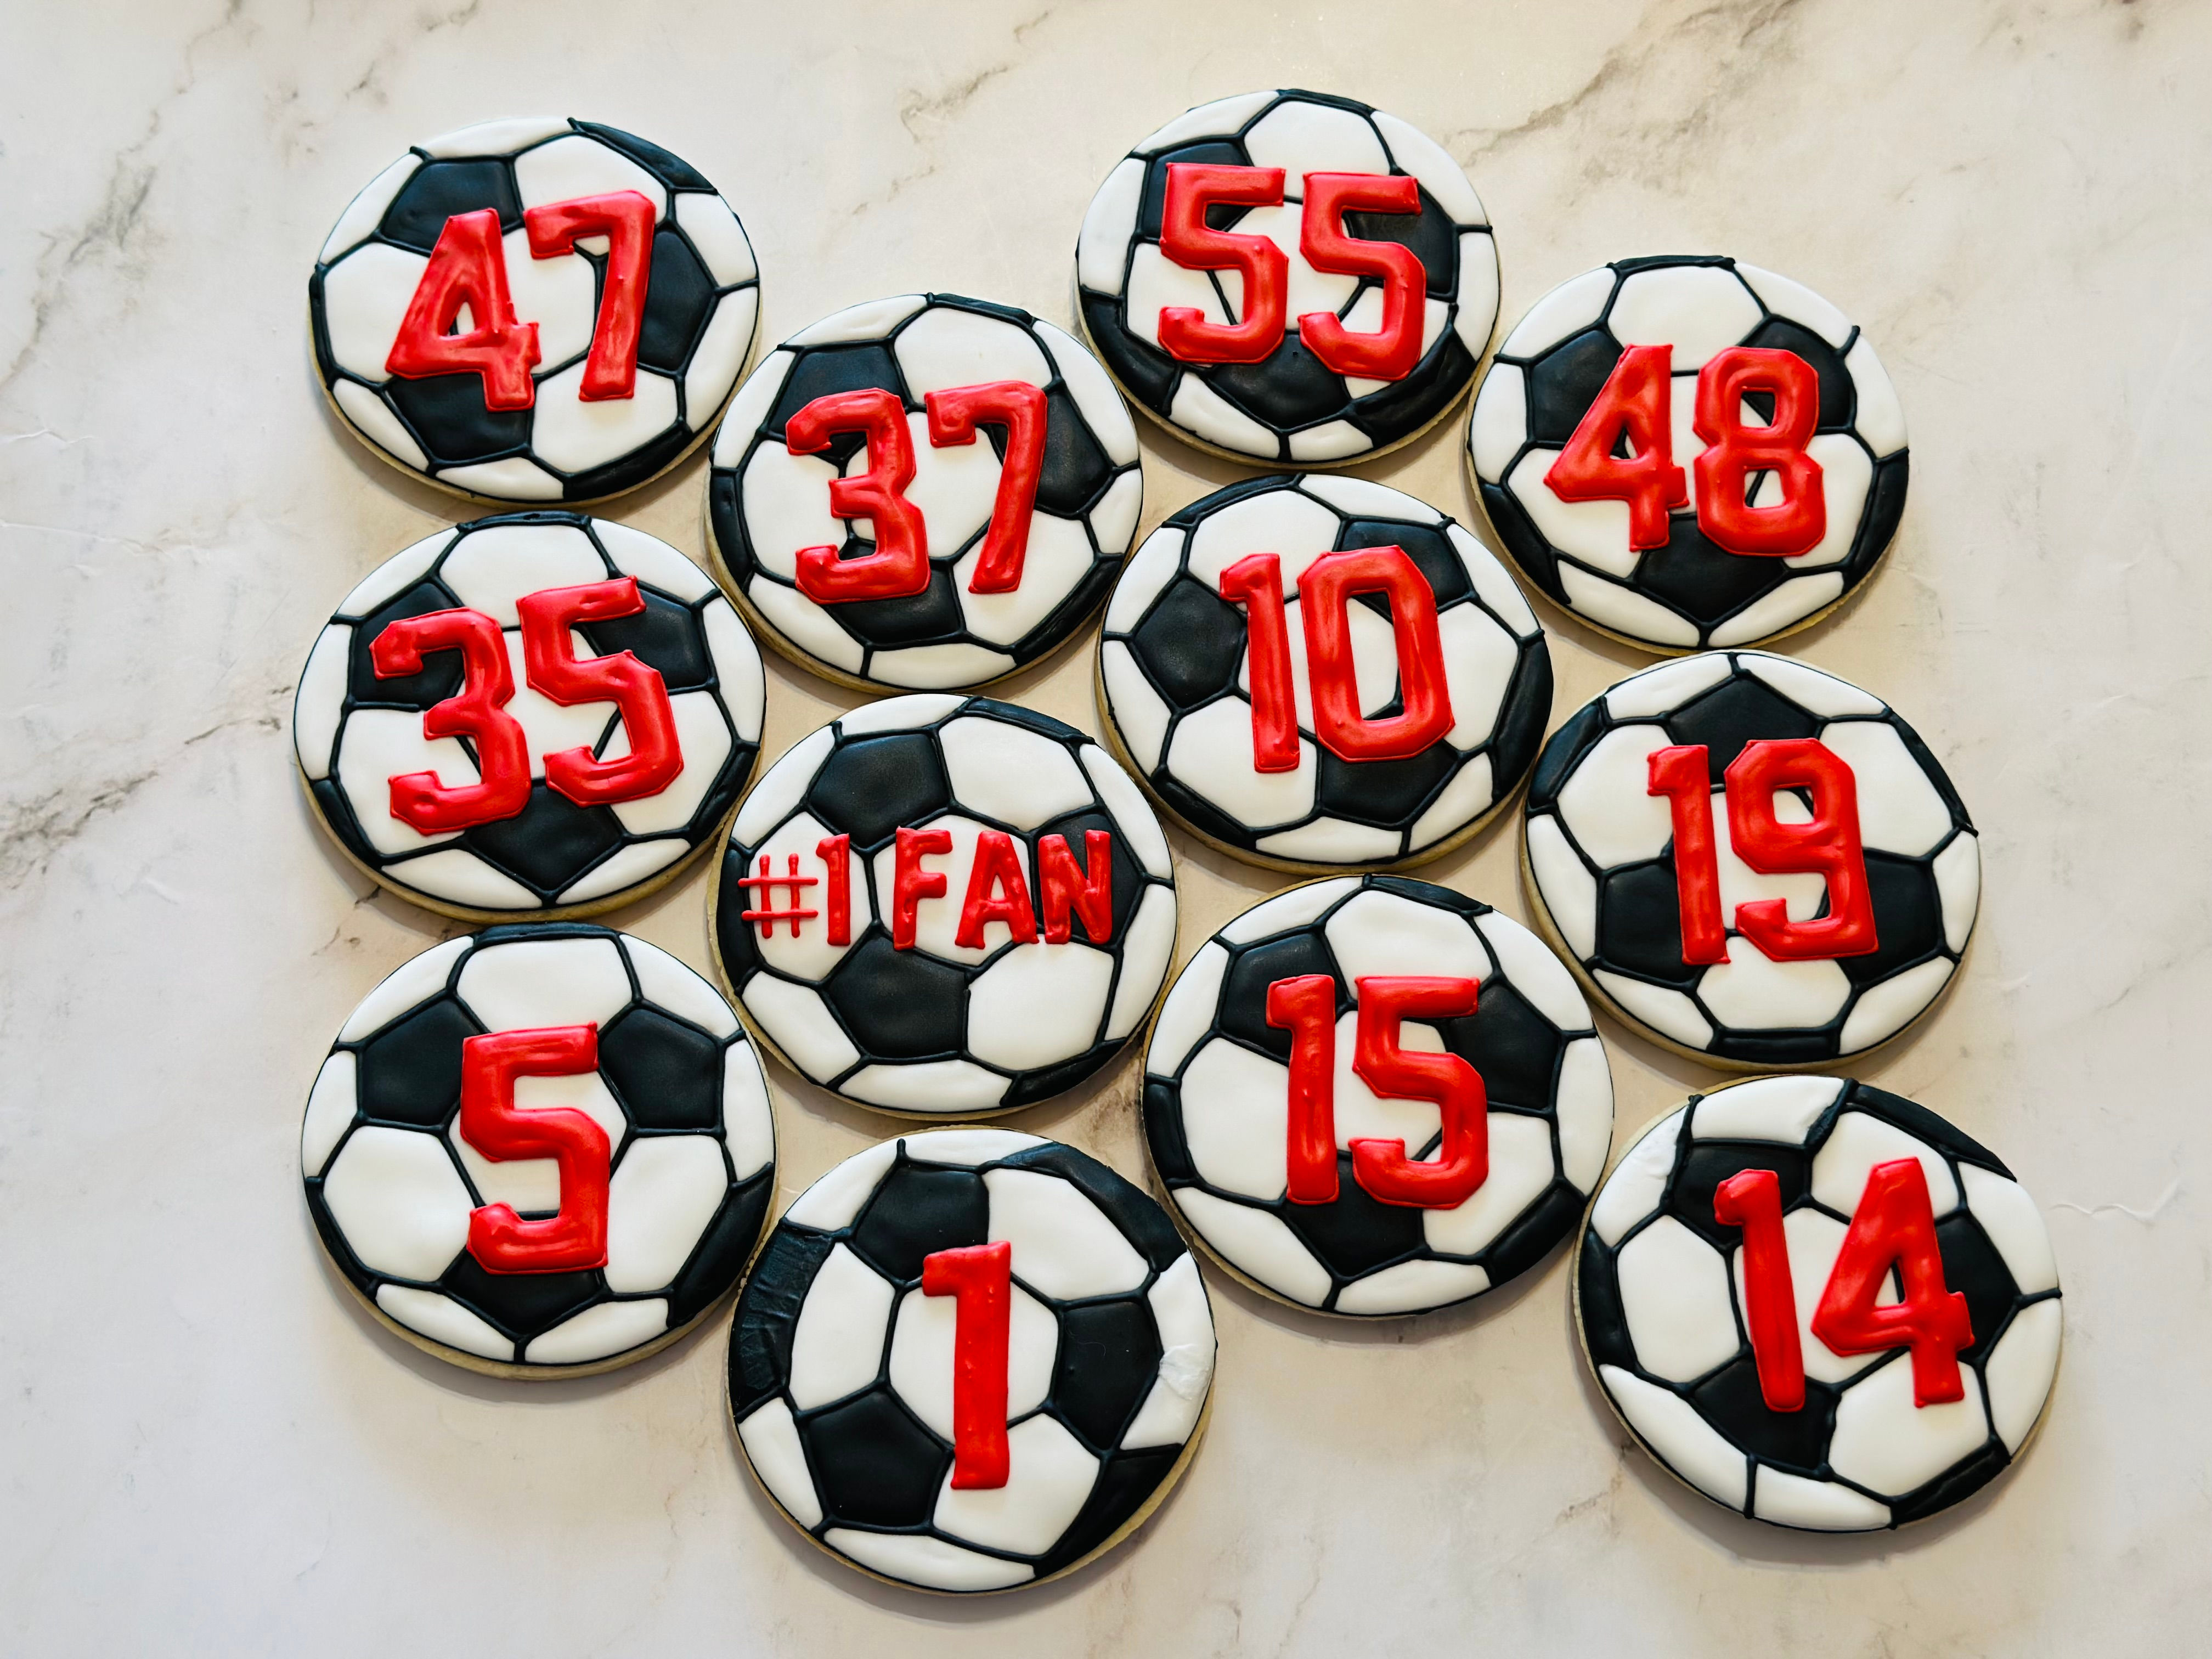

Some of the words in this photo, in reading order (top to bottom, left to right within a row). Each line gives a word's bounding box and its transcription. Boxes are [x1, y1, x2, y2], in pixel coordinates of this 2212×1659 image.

[385, 190, 657, 411] 47
[1157, 163, 1426, 380] 55
[786, 380, 1048, 603] 37
[1543, 343, 1827, 556] 48
[370, 575, 684, 835] 35
[1220, 545, 1455, 774] 10
[738, 833, 852, 946] #1
[893, 827, 1113, 950] FAN
[1647, 738, 1878, 965] 19
[460, 1021, 611, 1274] 5
[1265, 974, 1489, 1210] 15
[922, 1240, 1012, 1489] 1
[1714, 1156, 1975, 1412] 14
